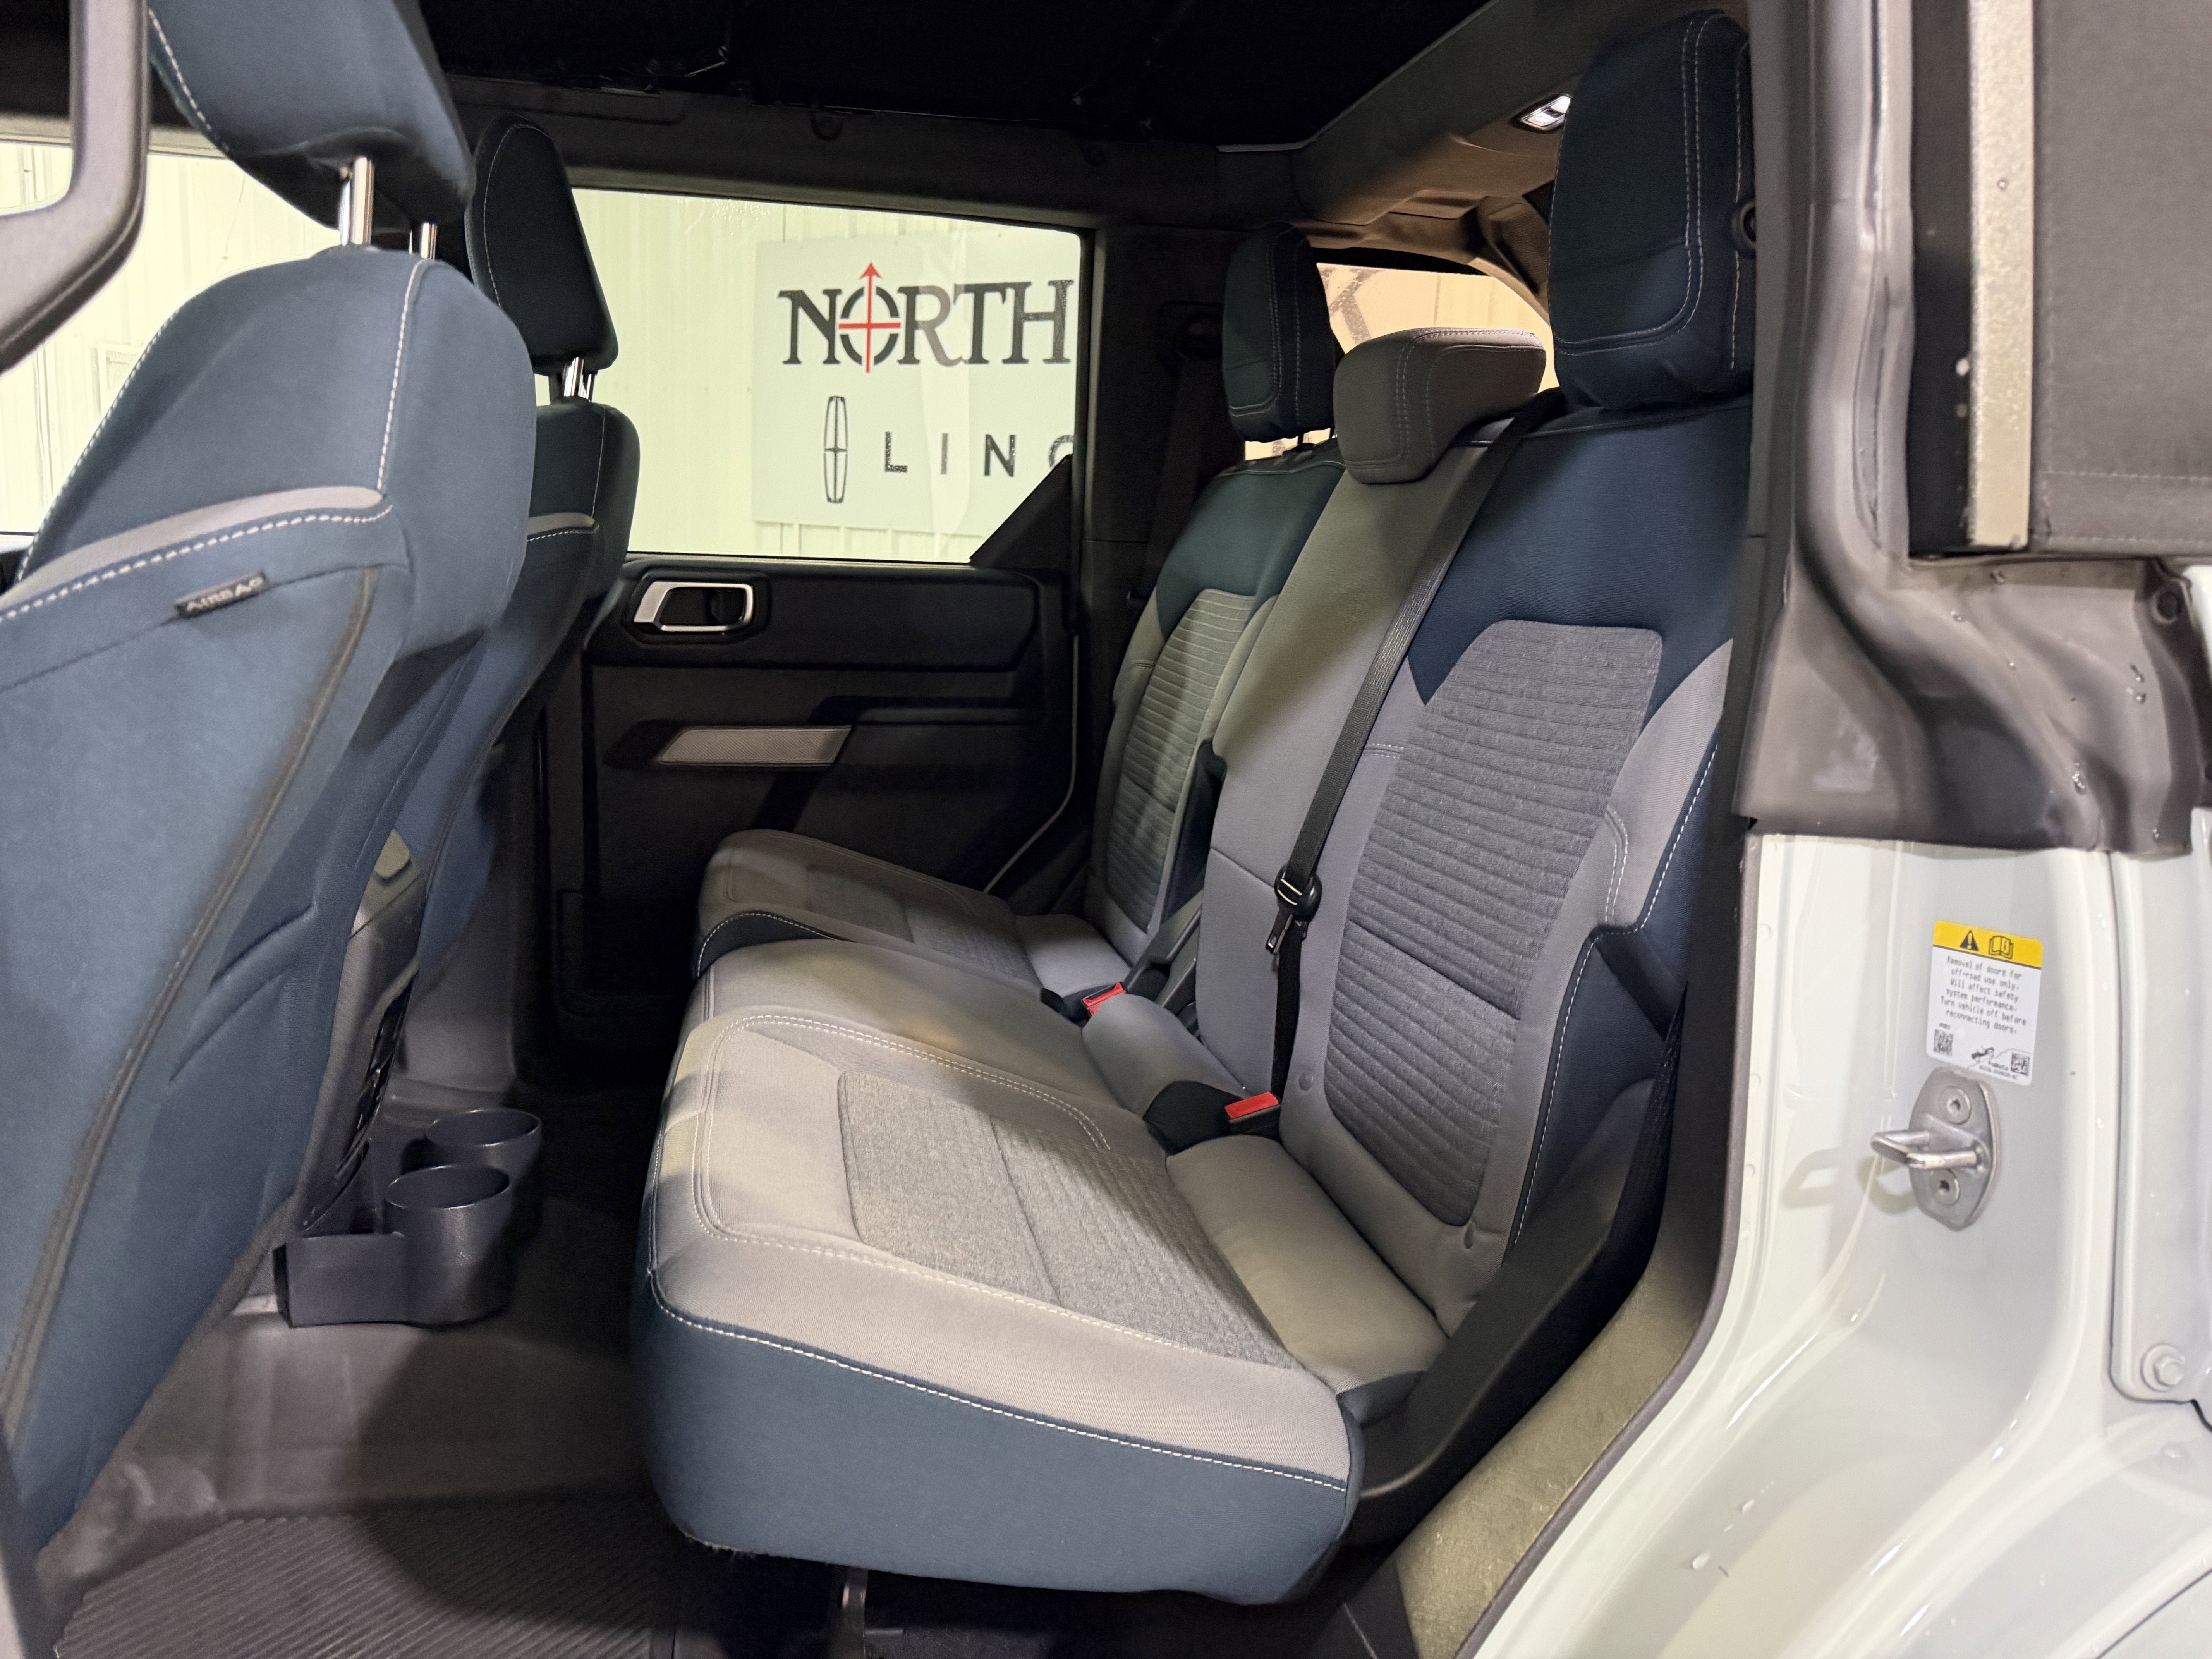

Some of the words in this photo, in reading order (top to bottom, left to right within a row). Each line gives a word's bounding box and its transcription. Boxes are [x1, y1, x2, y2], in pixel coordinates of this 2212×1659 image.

[778, 279, 1074, 367] NORTH
[1947, 955, 1972, 969] Removal
[2009, 970, 2022, 979] for
[1950, 978, 1964, 988] Will
[1968, 983, 1990, 995] affect
[1995, 990, 2019, 1003] safety
[1951, 968, 1981, 981] off-road
[1984, 977, 1995, 985] use
[2000, 980, 2019, 991] only.
[1941, 996, 1955, 1007] Turn
[1958, 1002, 1984, 1015] vehicle
[1987, 1008, 1998, 1018] off
[2002, 1012, 2027, 1026] before
[1946, 989, 1968, 999] system
[1971, 995, 2017, 1012] performance.
[1946, 1009, 1990, 1029] reconnecting
